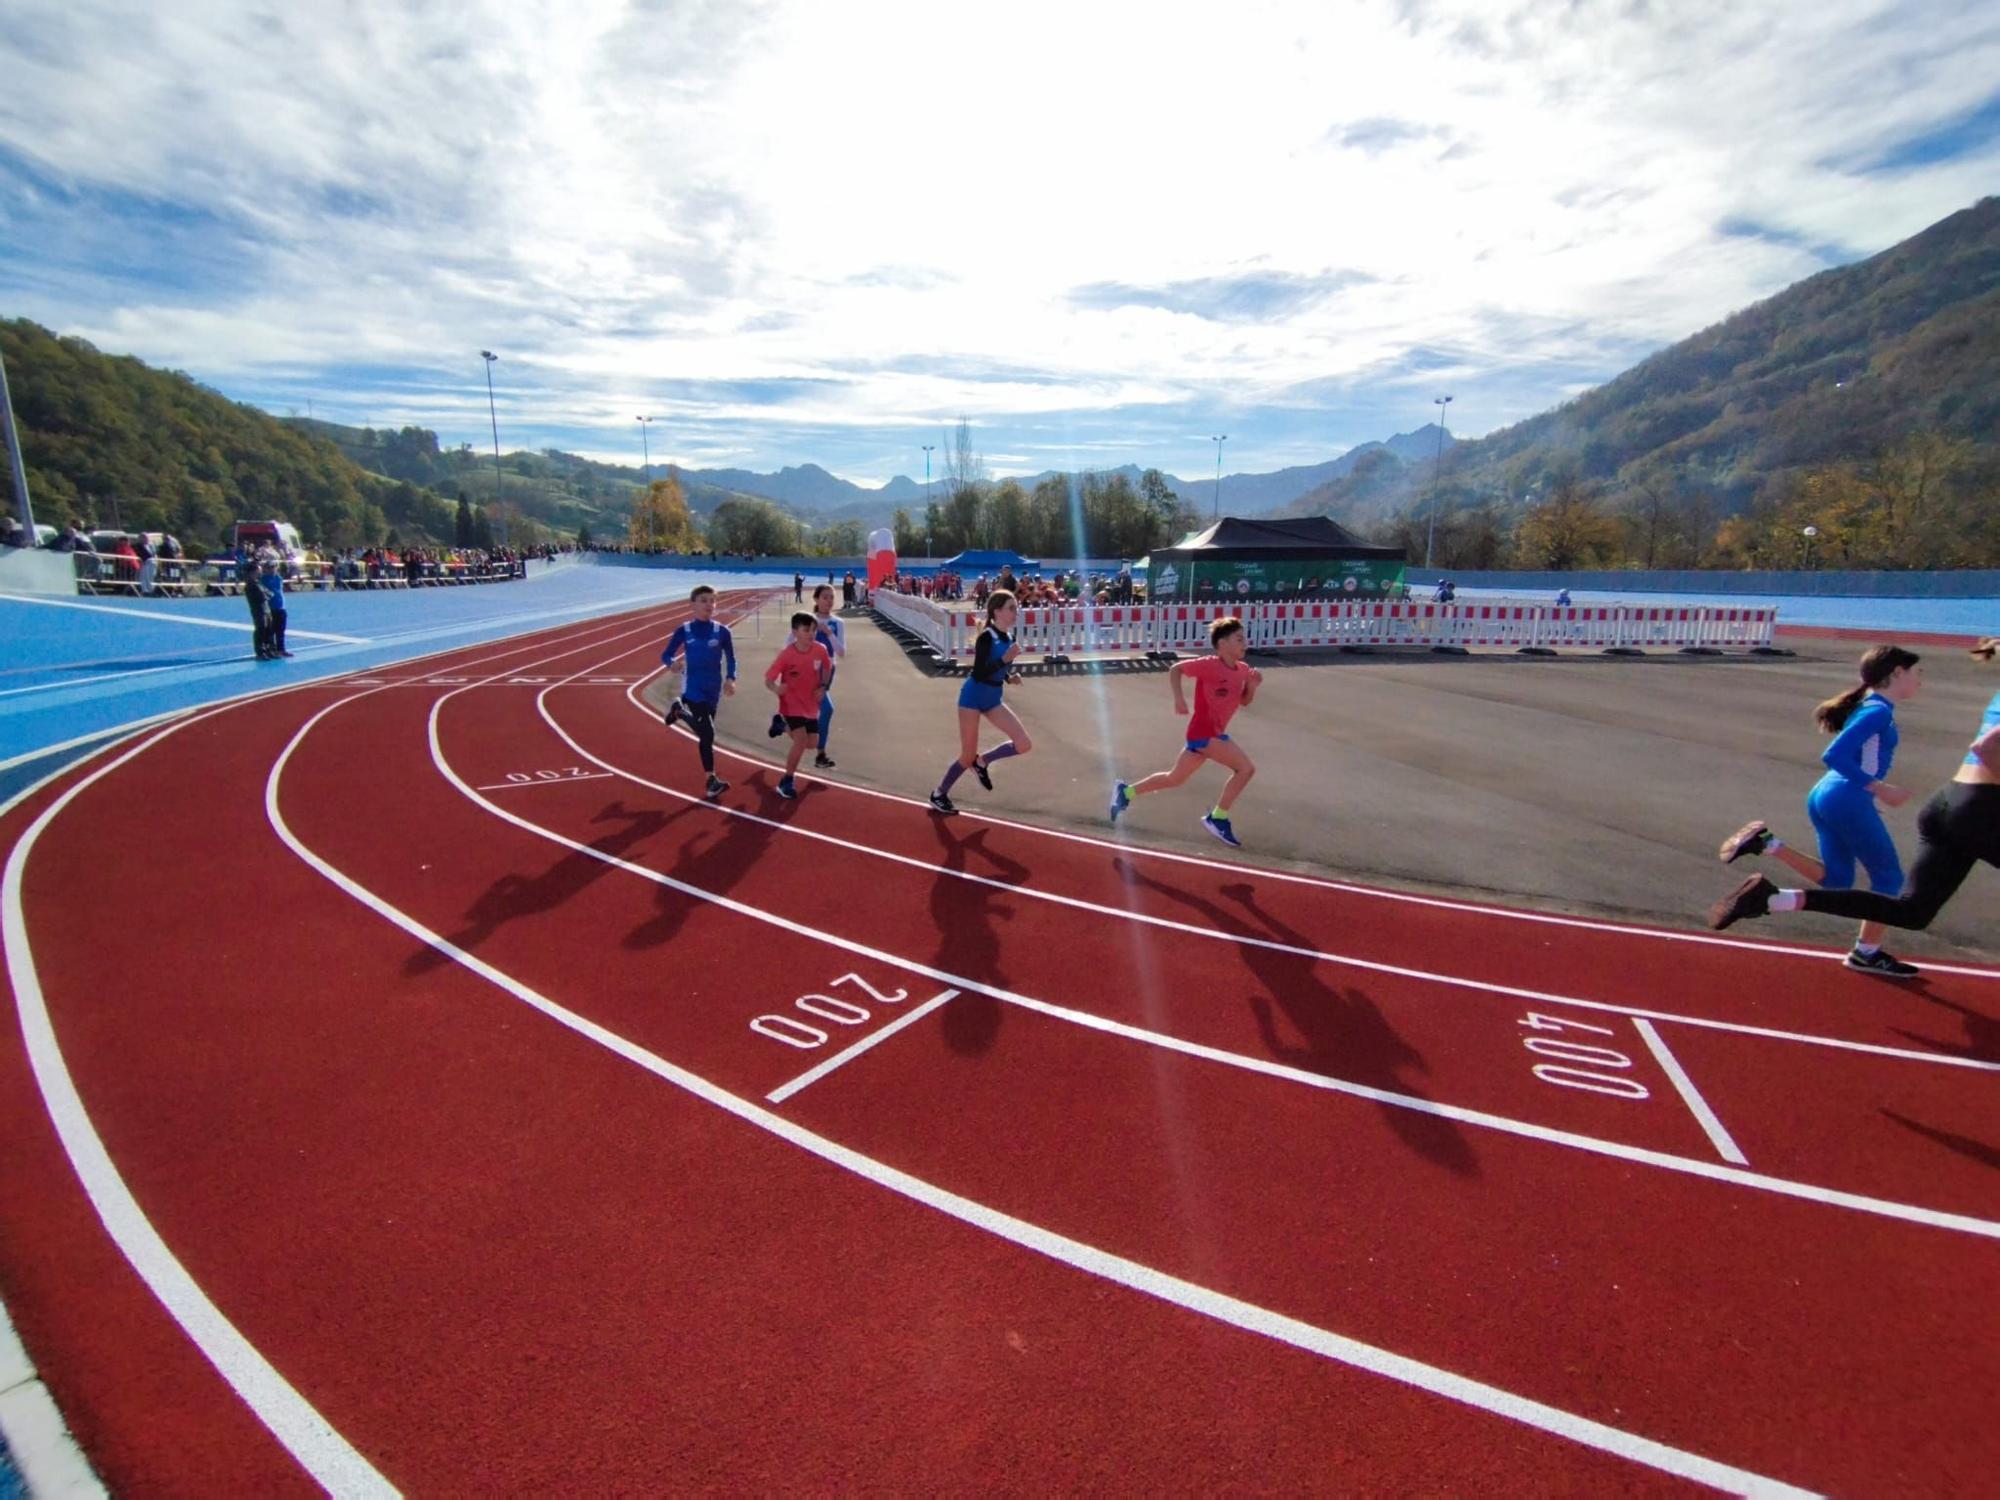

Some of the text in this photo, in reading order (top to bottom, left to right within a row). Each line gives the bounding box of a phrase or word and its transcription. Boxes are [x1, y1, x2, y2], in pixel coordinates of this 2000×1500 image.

[506, 766, 590, 782] 200
[749, 972, 908, 1049] 200
[1517, 1011, 1649, 1099] 400
